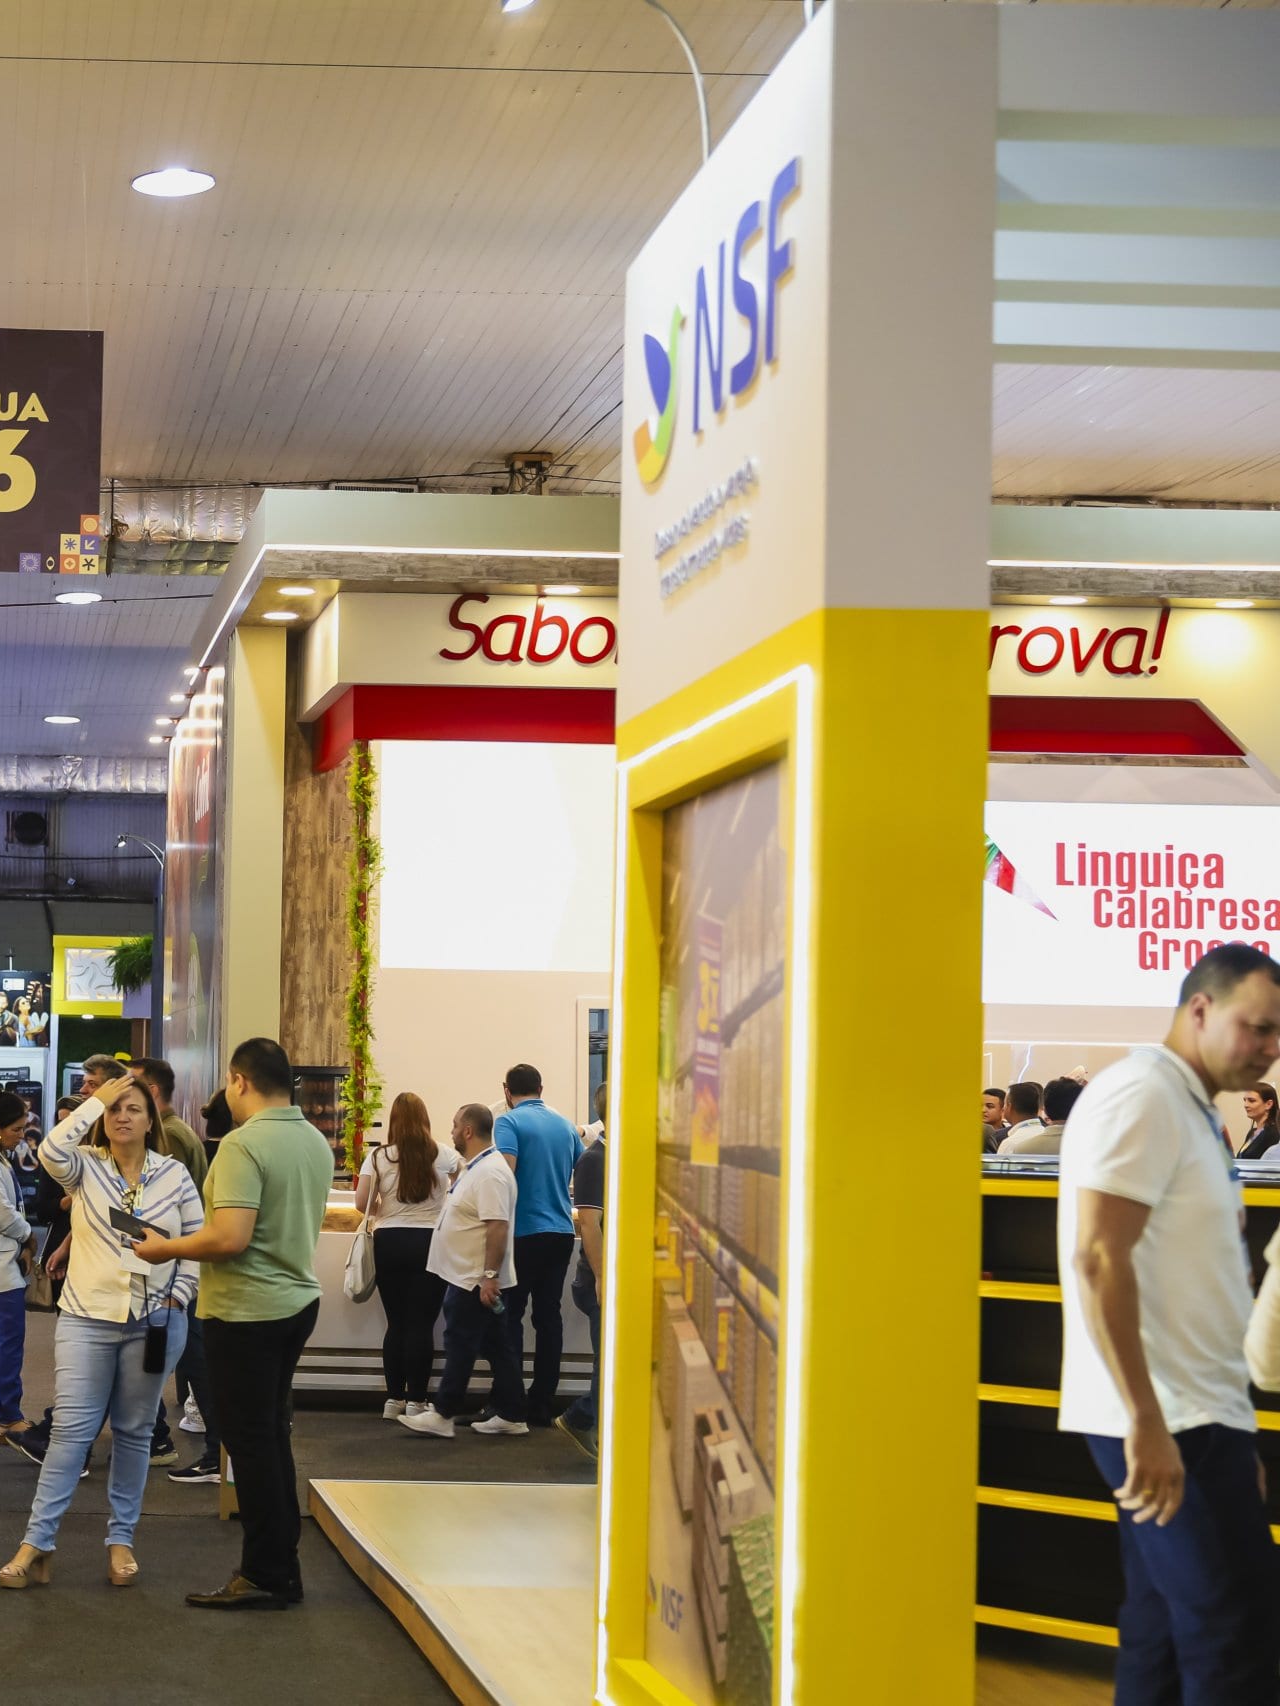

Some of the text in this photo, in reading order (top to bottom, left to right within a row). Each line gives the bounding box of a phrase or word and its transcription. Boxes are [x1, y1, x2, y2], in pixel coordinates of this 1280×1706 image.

[693, 157, 800, 434] NSF
[439, 592, 618, 664] Sabo
[1056, 842, 1224, 895] Linguiça
[1093, 889, 1280, 931] Calabresa
[1138, 931, 1270, 971] Gro
